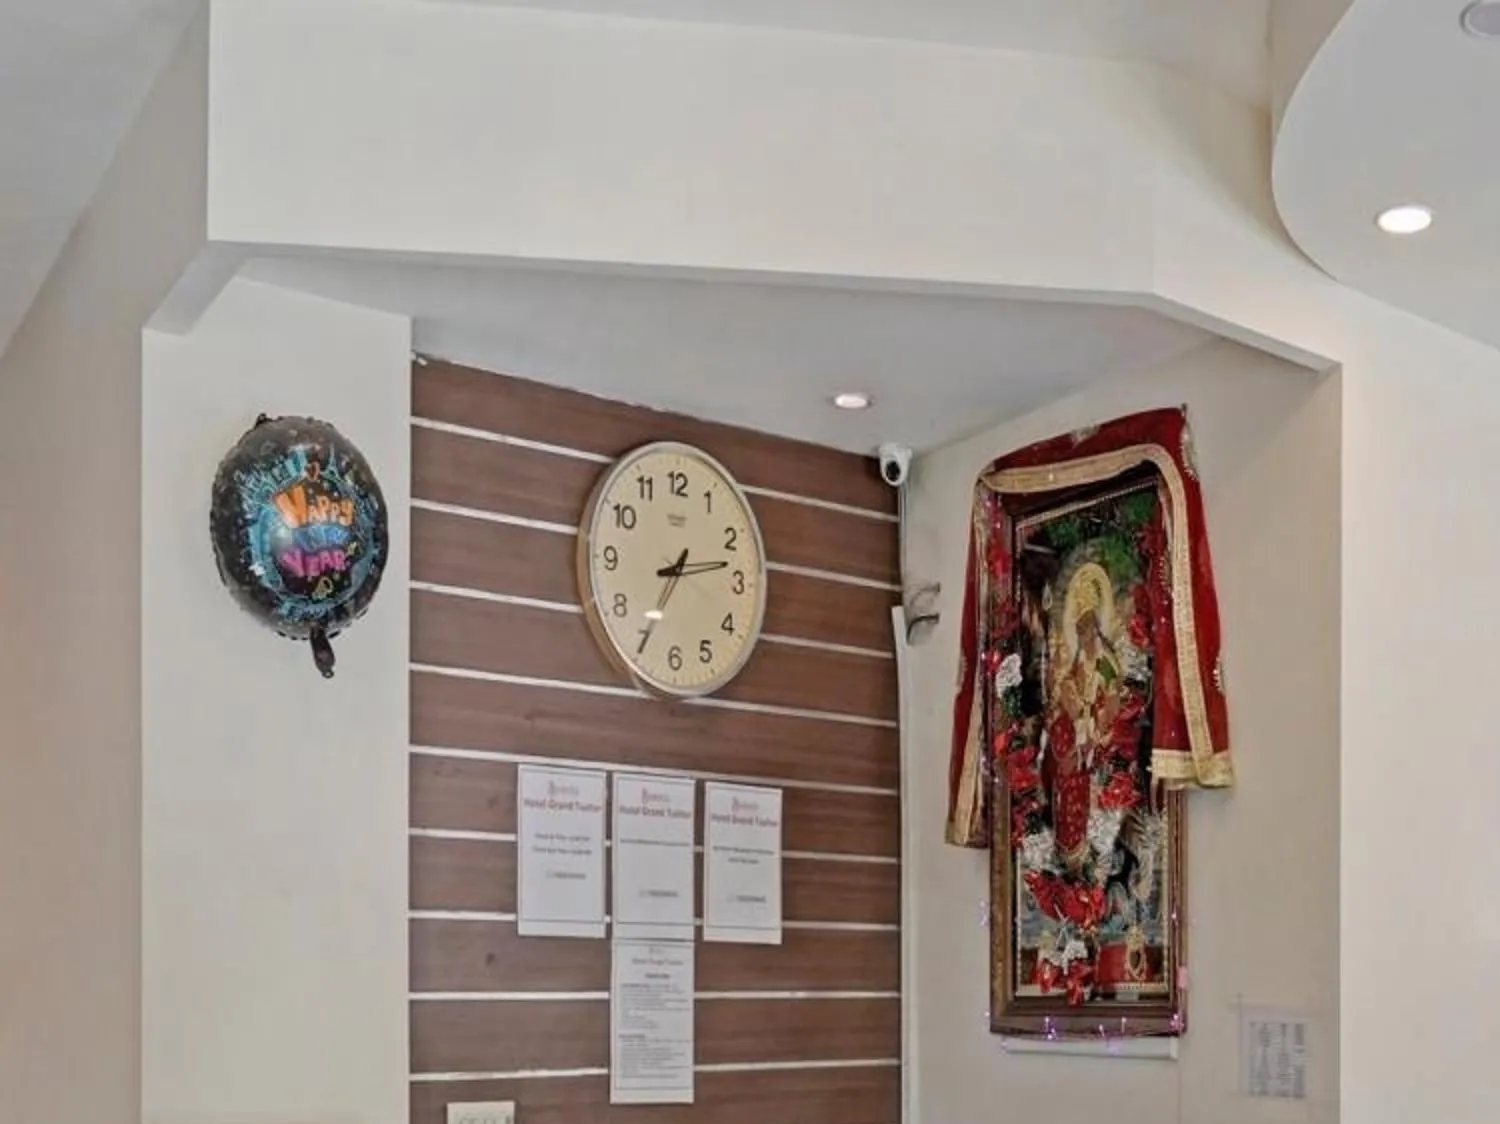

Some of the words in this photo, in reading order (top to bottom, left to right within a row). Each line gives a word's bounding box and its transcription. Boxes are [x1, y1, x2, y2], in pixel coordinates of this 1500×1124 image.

[637, 476, 653, 501] 11
[667, 471, 688, 497] 12
[703, 491, 712, 513] 1
[613, 503, 637, 529] 10
[724, 527, 737, 551] 2
[603, 545, 618, 571] 9
[732, 570, 745, 594] 3
[613, 593, 628, 618] 8
[721, 613, 735, 636] 4
[637, 629, 651, 654] 7
[699, 639, 713, 663] 5
[668, 645, 683, 671] 6
